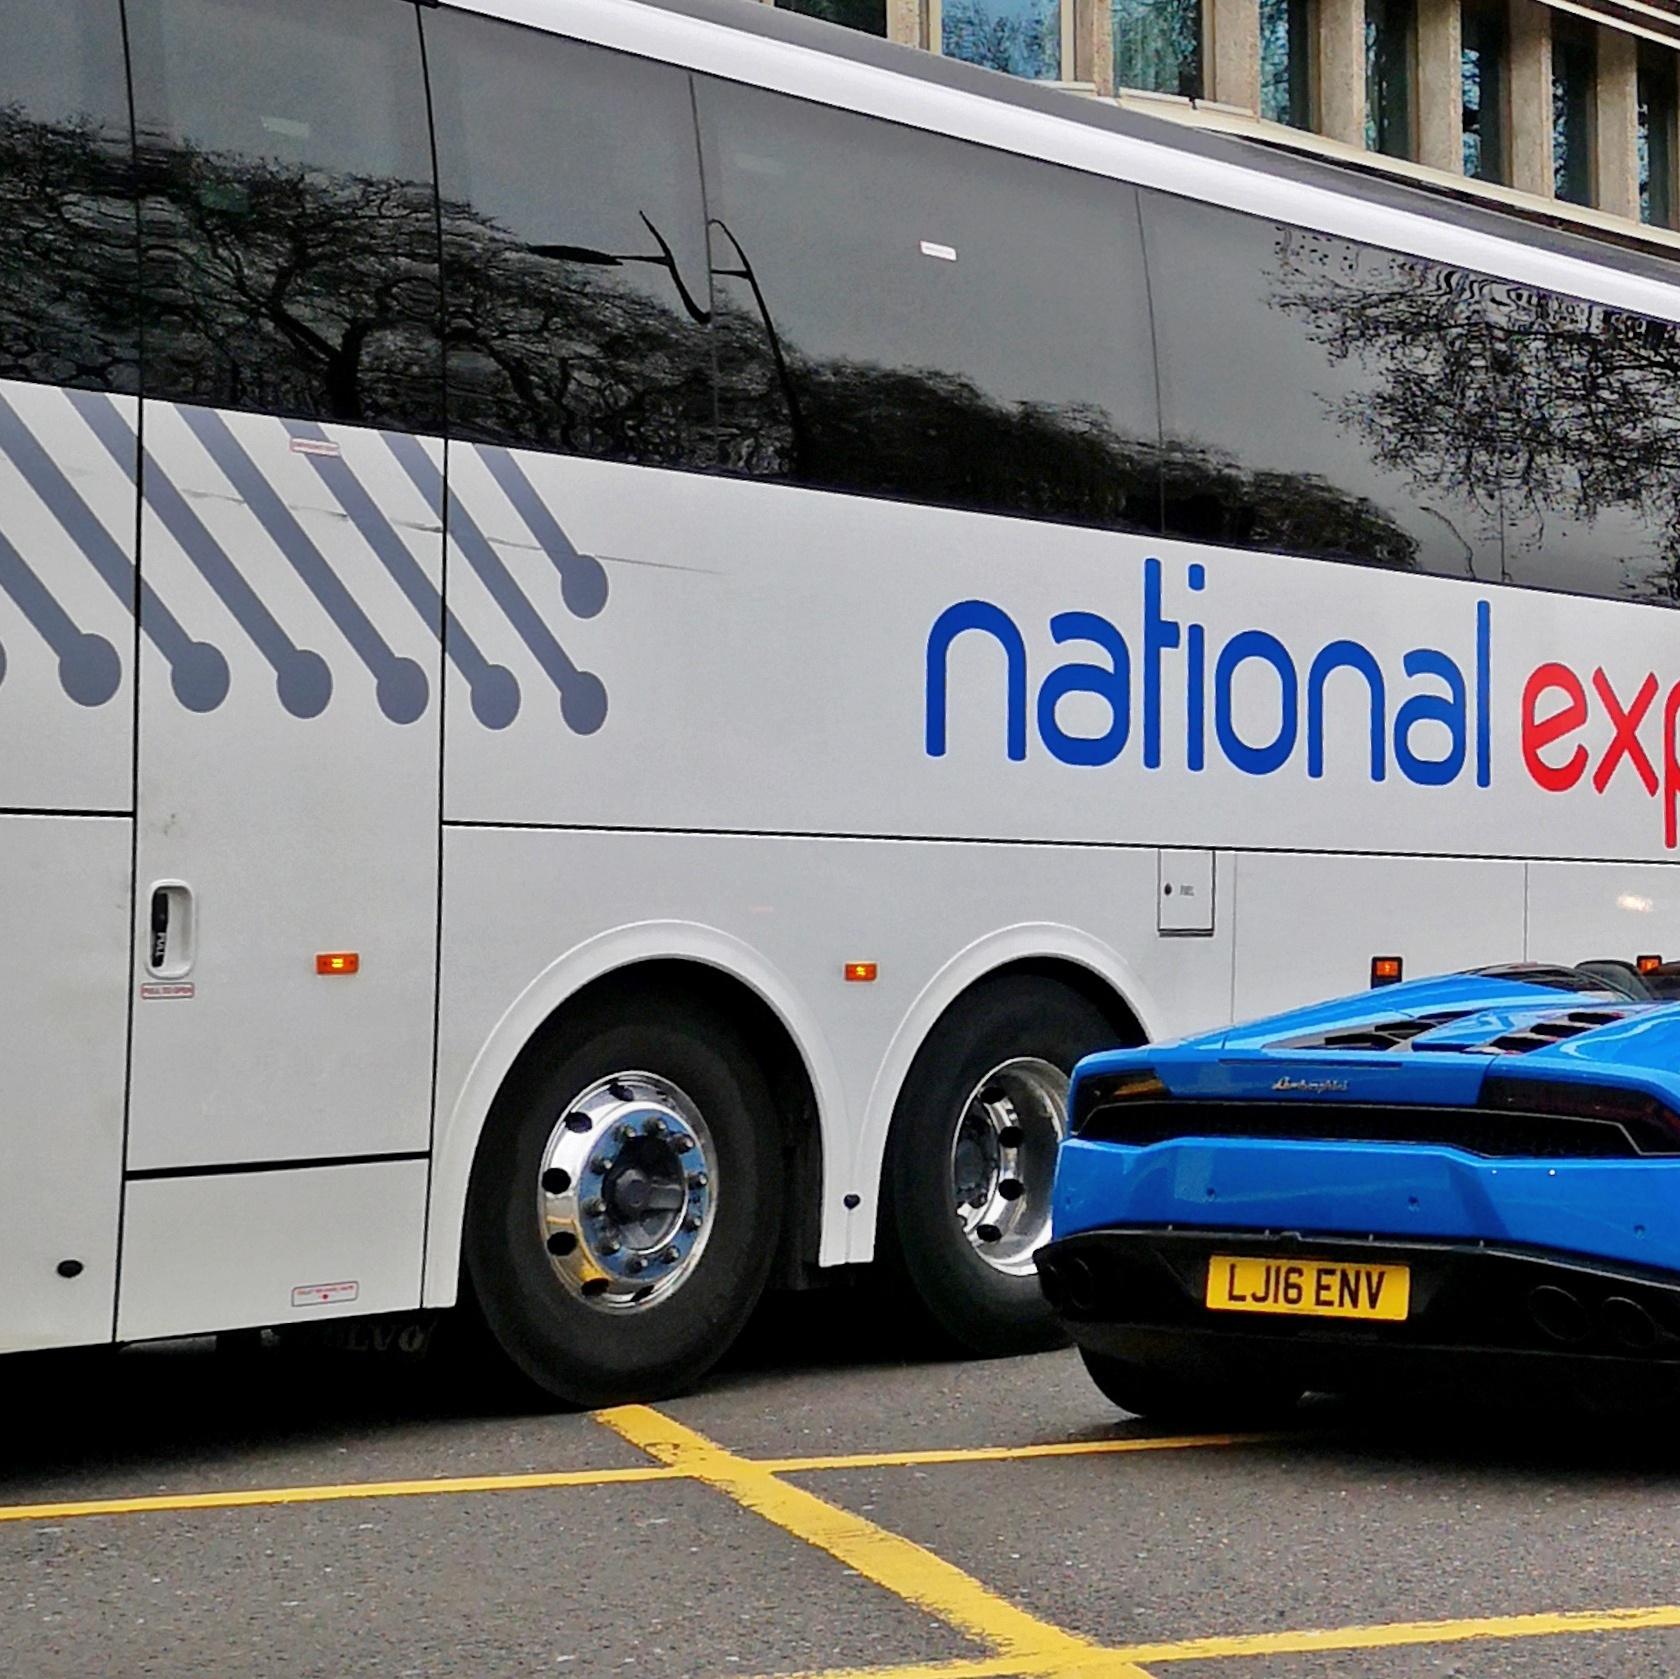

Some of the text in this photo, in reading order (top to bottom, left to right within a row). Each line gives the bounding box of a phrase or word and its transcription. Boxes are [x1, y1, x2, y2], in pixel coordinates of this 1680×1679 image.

[925, 558, 1491, 788] national
[1227, 1263, 1386, 1310] LJ16 ENV
